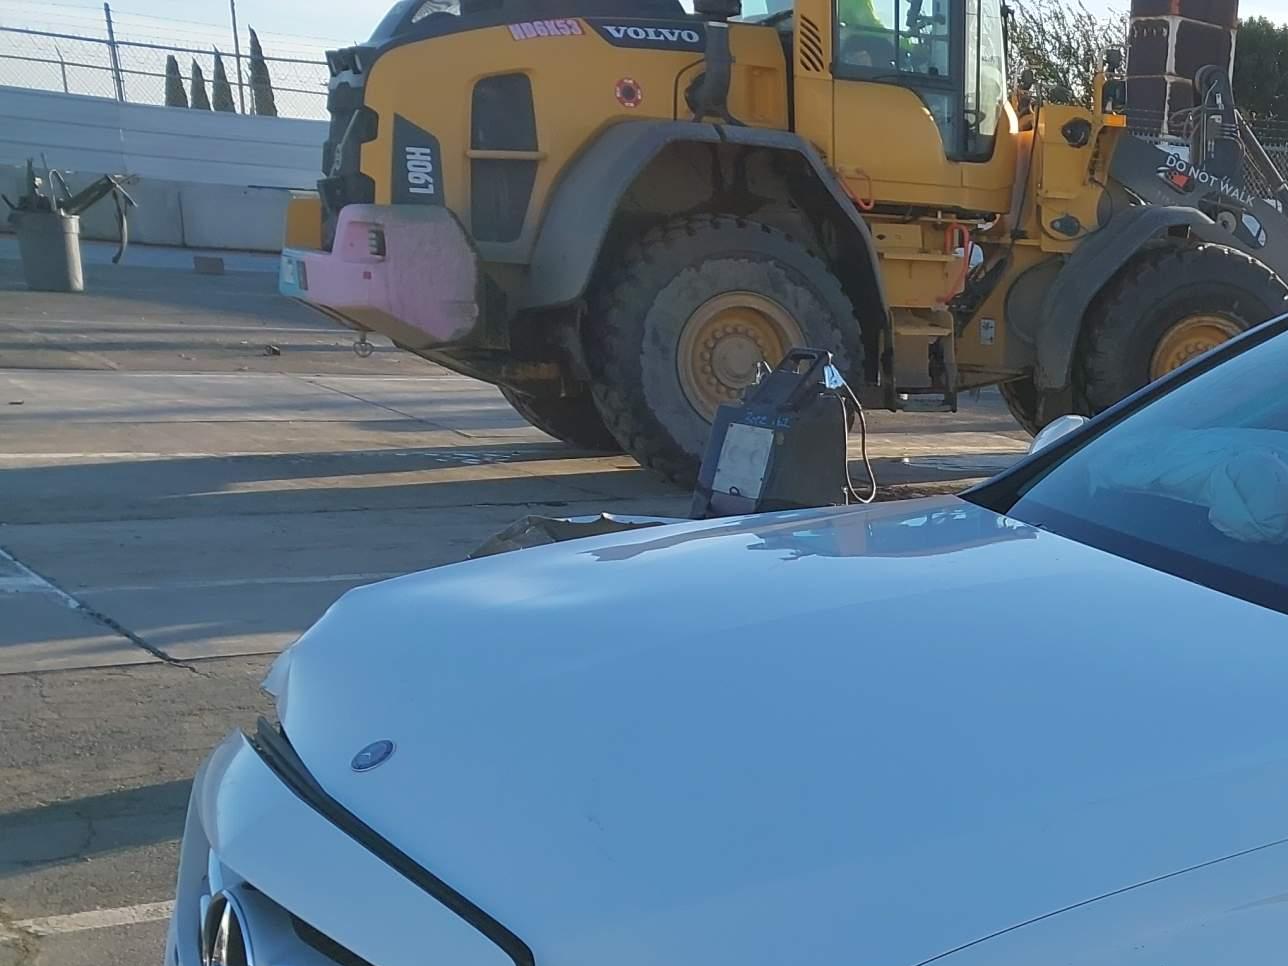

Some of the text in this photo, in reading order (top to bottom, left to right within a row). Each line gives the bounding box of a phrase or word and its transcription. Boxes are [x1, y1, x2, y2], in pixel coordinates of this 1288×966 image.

[602, 26, 700, 43] VOLVO
[405, 146, 435, 194] L90H
[1165, 154, 1255, 207] DO NOT WALK
